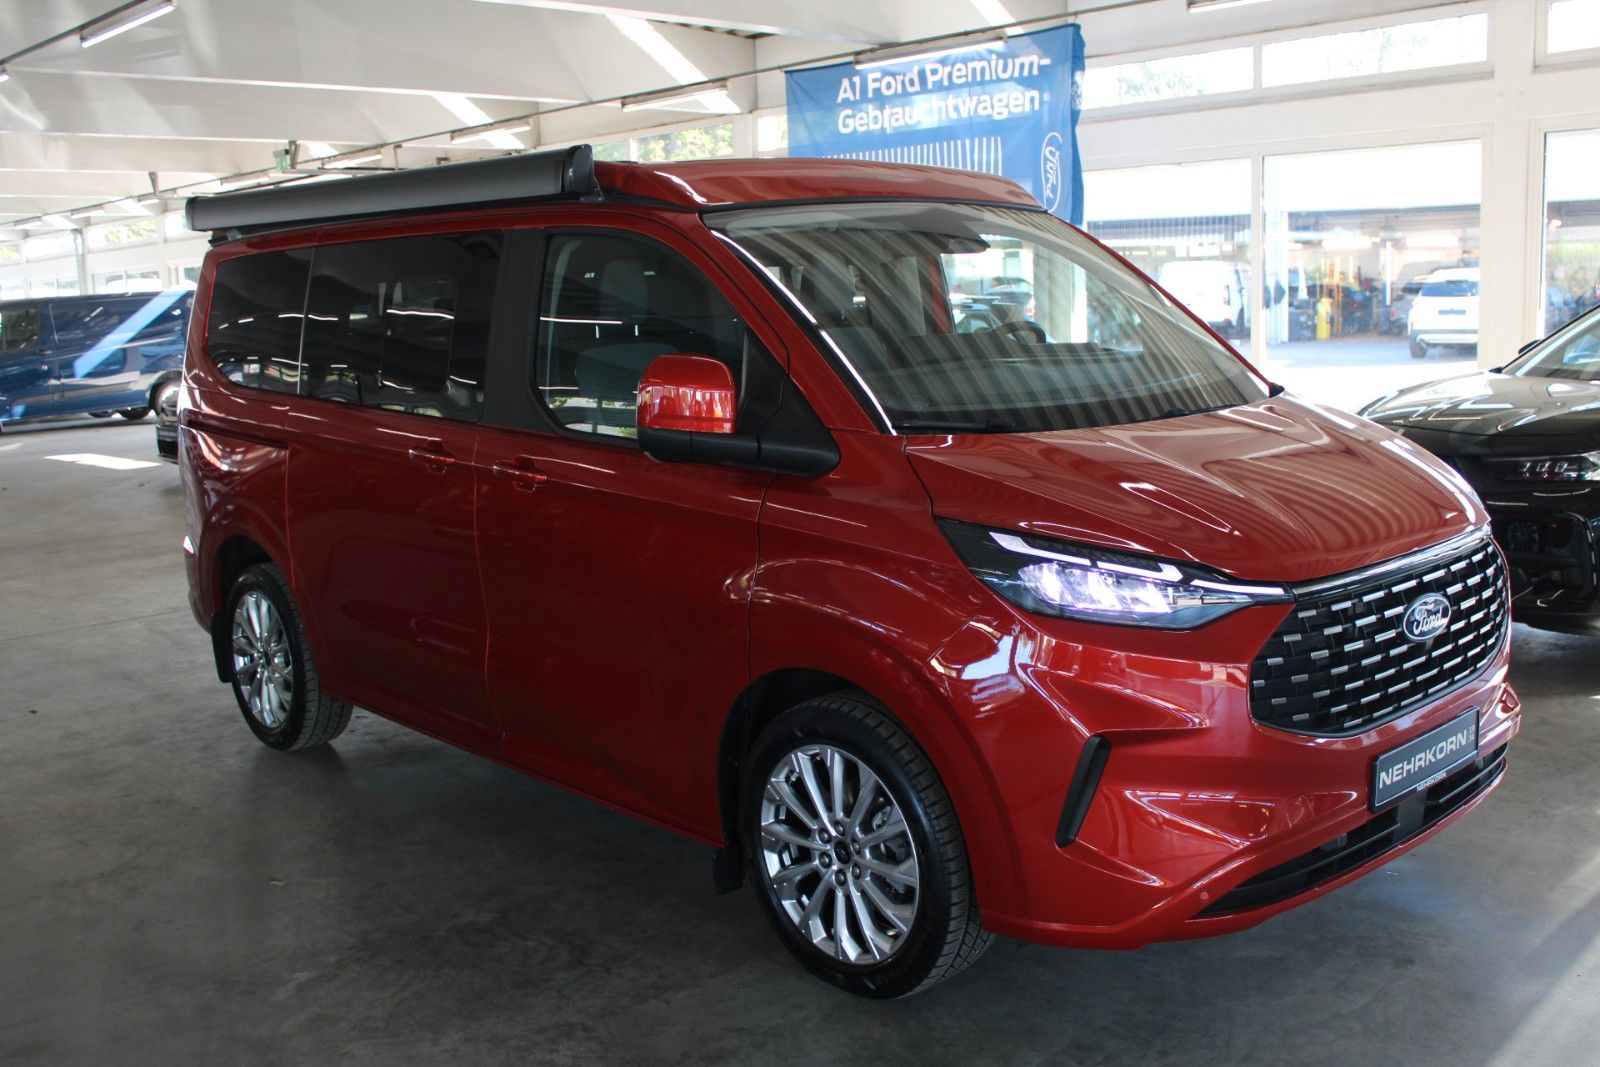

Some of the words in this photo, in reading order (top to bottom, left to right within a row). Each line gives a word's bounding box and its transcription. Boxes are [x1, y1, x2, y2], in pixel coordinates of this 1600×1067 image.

[867, 65, 921, 98] Ford
[926, 53, 1052, 90] Premium-
[837, 88, 1041, 134] Gebrauchtwagen
[1411, 600, 1449, 636] Ford
[1379, 729, 1467, 789] NEHRKORN
